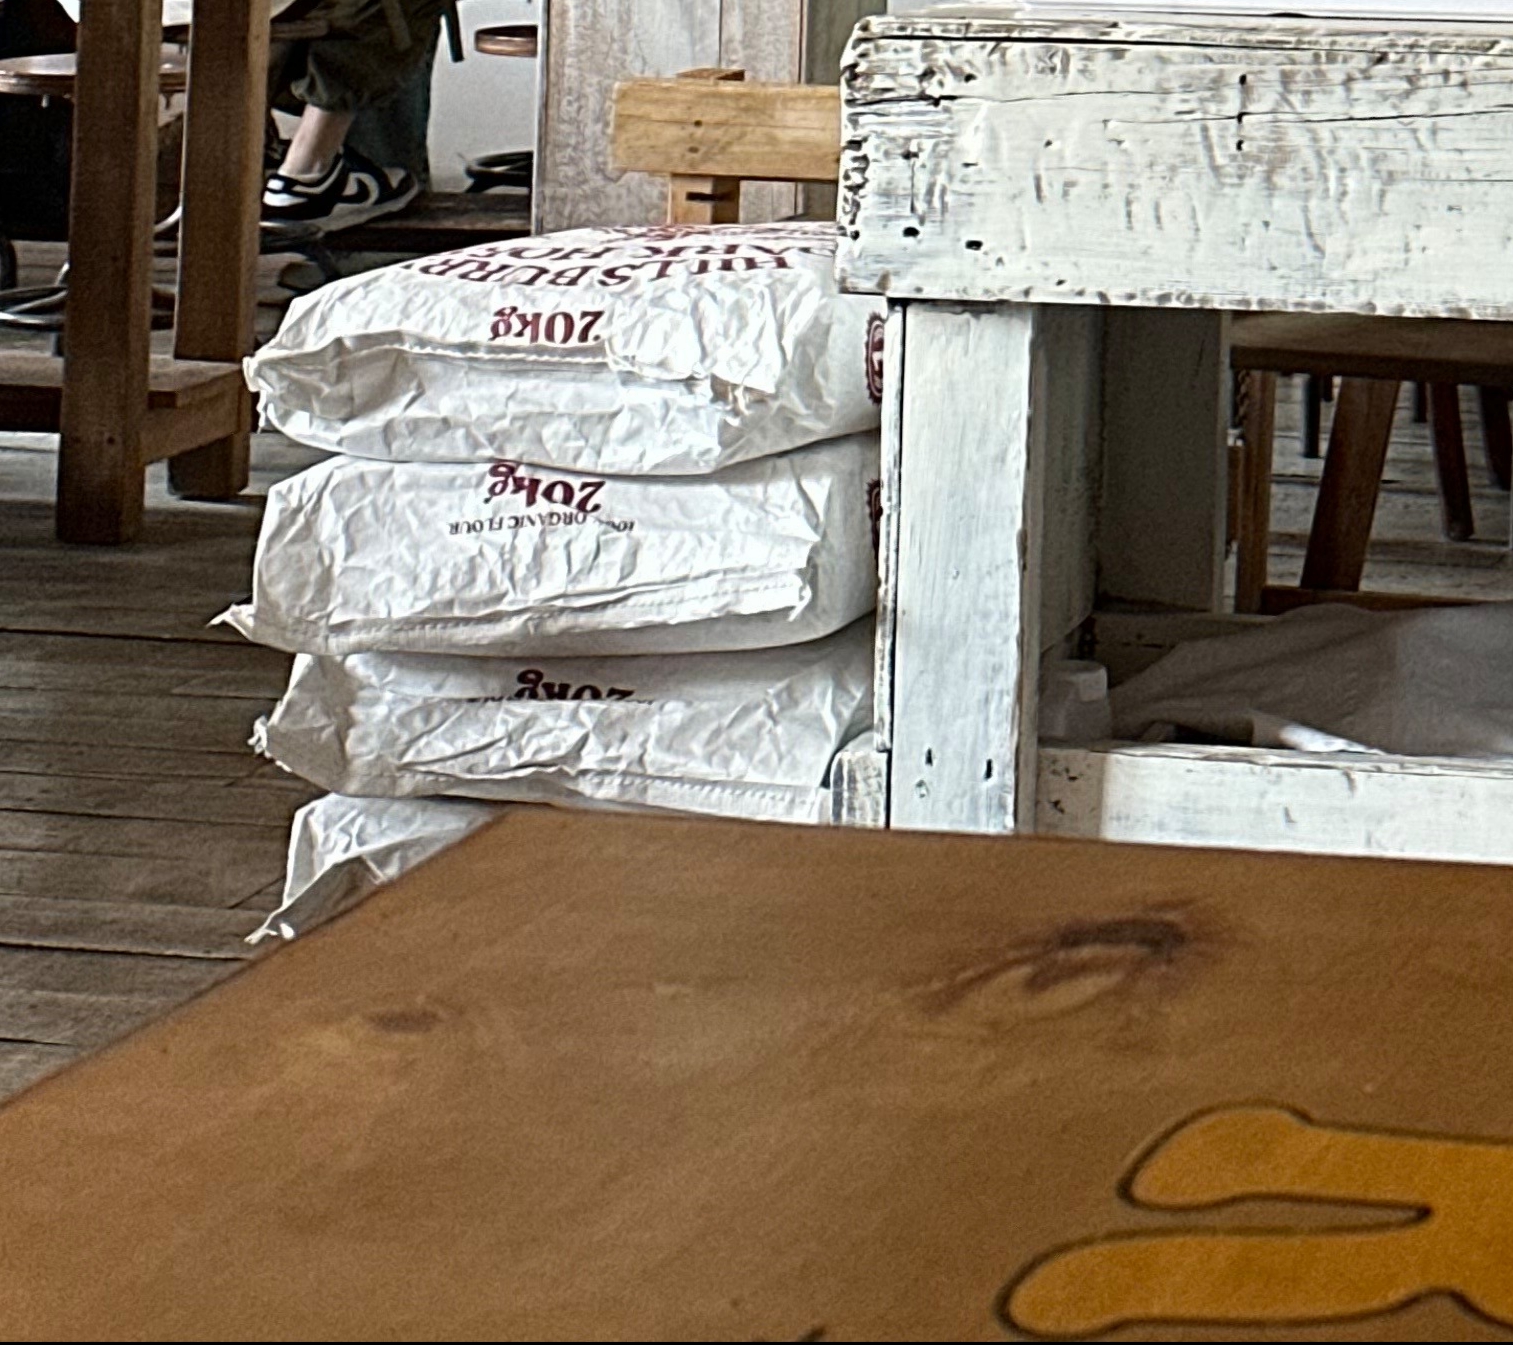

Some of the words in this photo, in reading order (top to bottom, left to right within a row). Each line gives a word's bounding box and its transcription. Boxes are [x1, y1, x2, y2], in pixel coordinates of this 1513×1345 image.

[489, 306, 605, 344] 20kg
[484, 461, 606, 514] 20kg
[447, 515, 505, 536] FLOUR
[510, 511, 589, 529] ORGANIC
